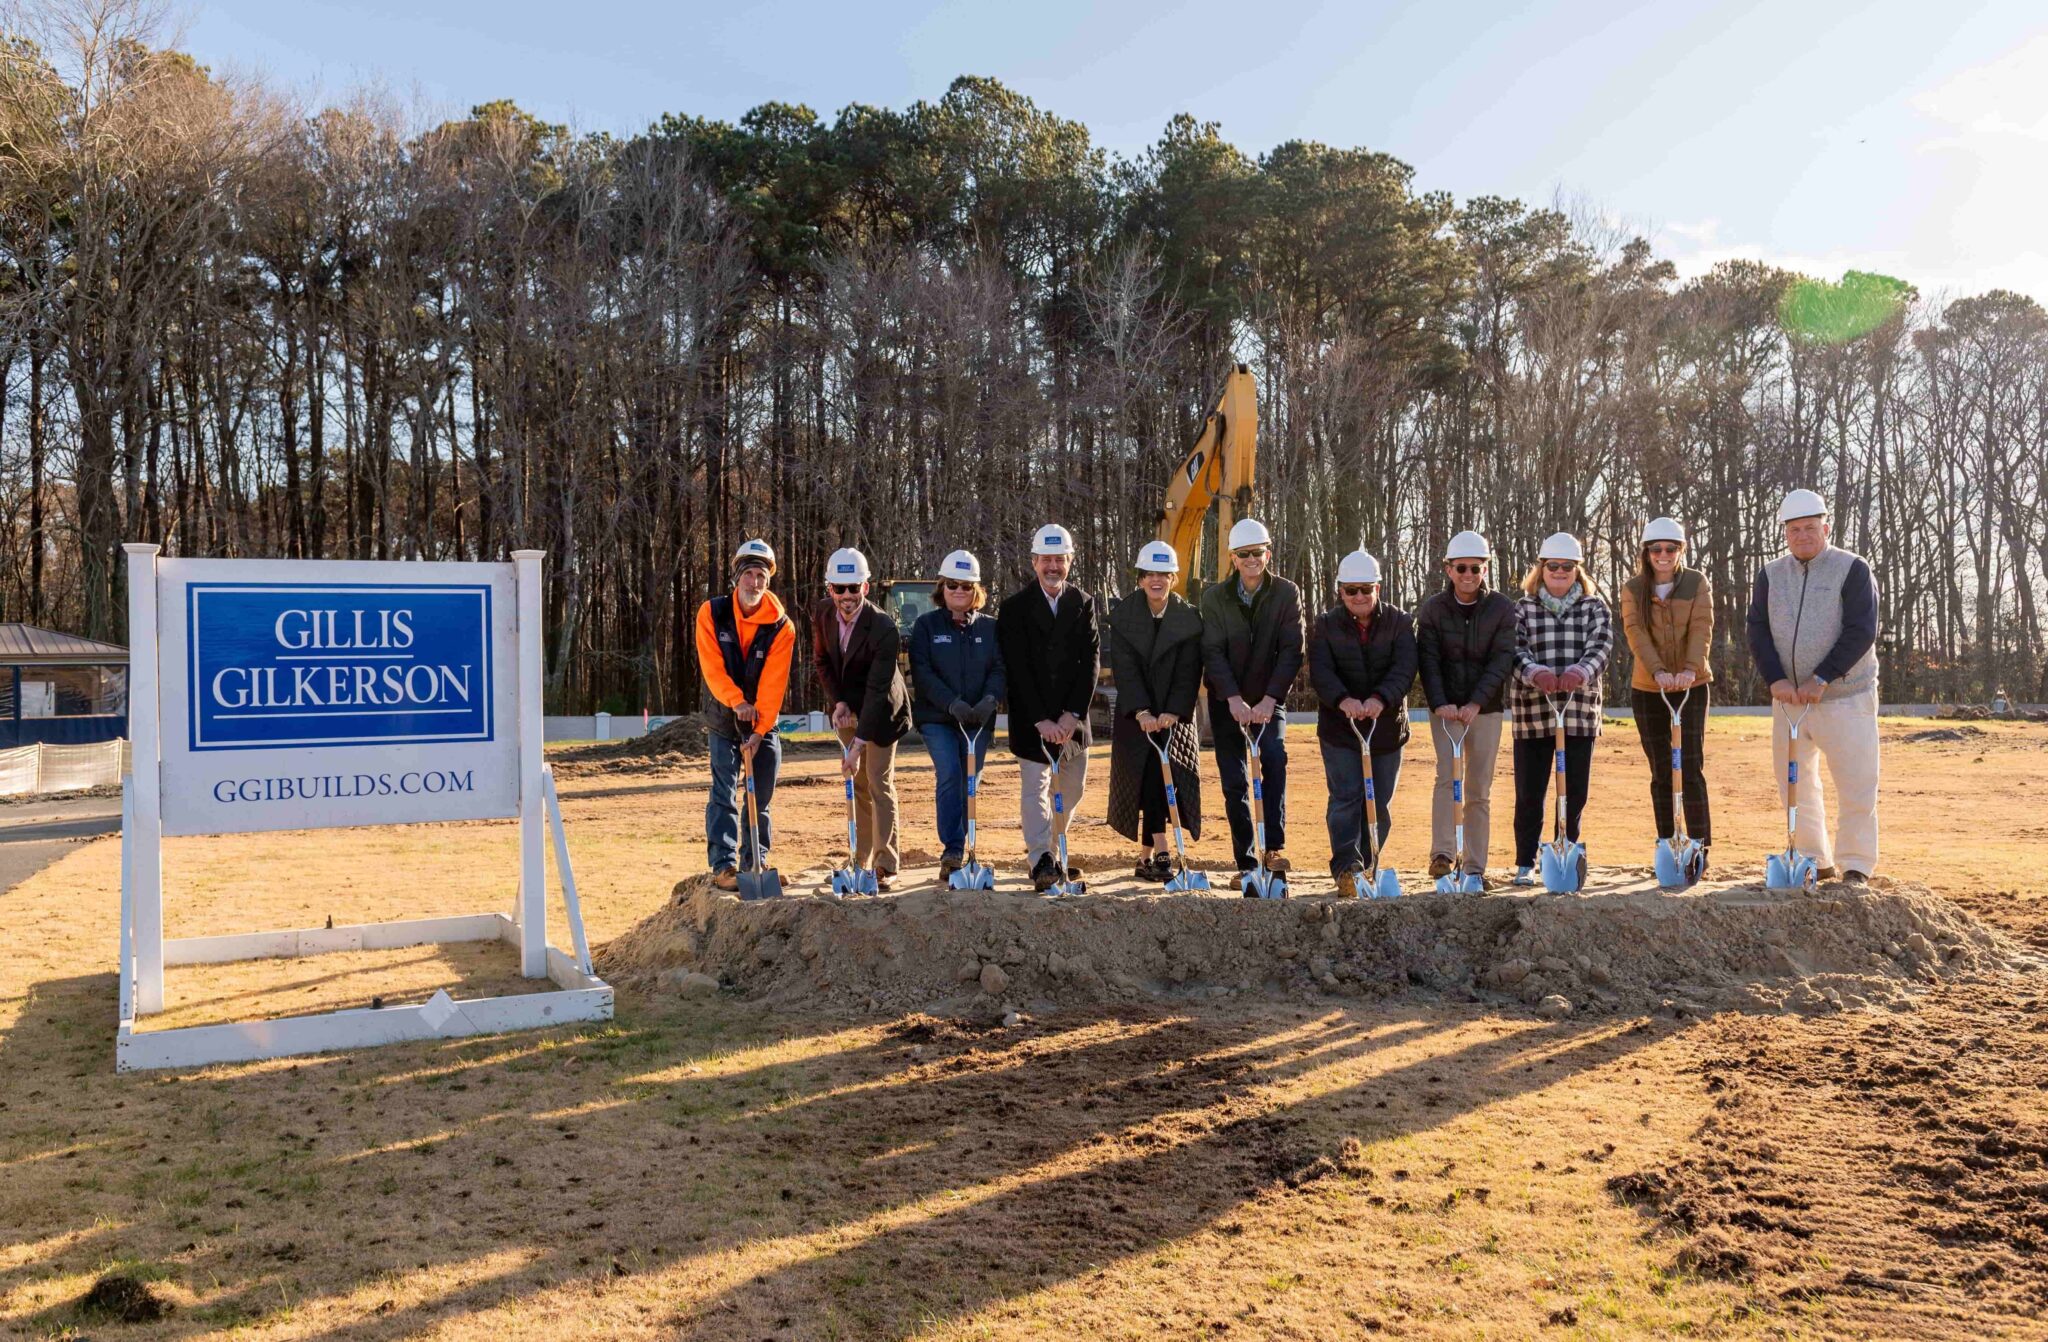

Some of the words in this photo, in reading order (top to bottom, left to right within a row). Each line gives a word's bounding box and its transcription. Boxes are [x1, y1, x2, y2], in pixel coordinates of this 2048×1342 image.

[275, 609, 414, 649] GILLIS
[212, 664, 472, 708] GILKERSON
[213, 770, 474, 803] GGIBUILDS.COM
